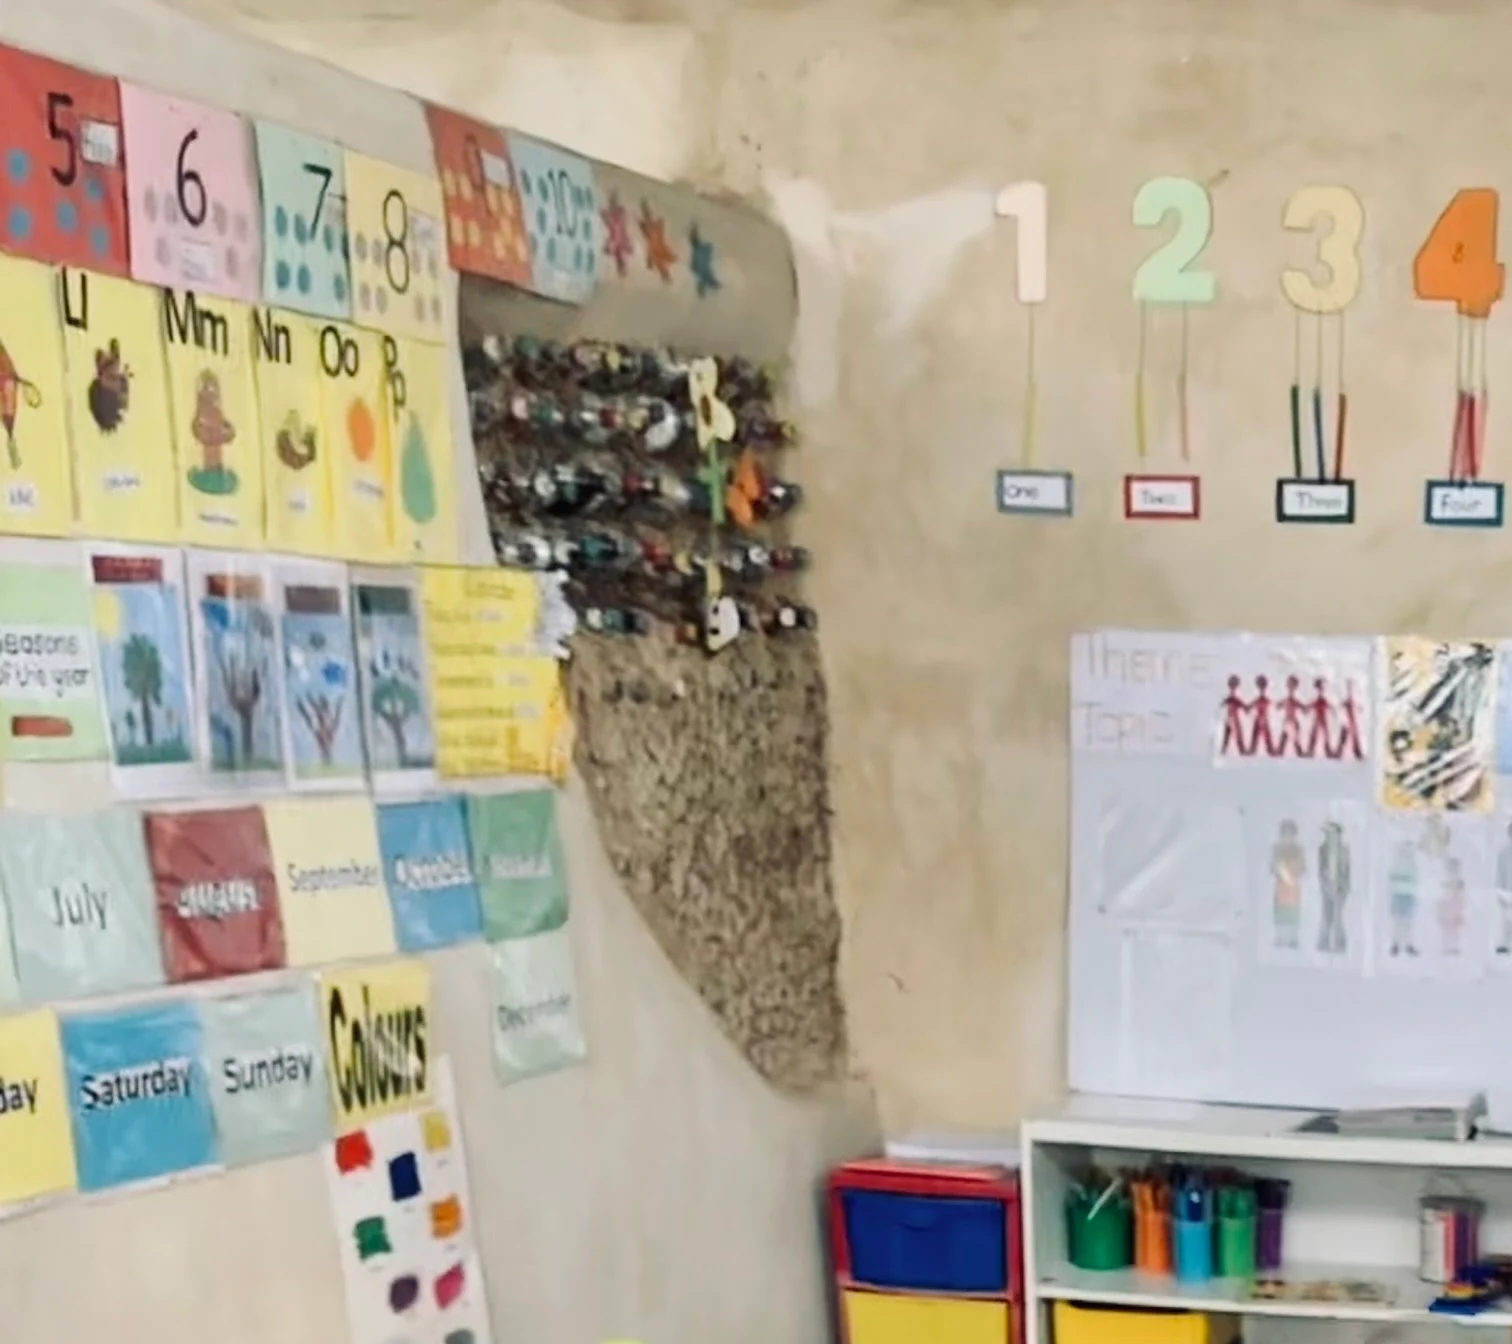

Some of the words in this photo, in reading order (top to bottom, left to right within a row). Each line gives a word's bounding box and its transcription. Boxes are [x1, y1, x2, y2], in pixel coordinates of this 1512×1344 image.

[46, 91, 77, 187] 5
[176, 128, 207, 227] 6
[303, 163, 333, 241] 7
[1132, 176, 1215, 302] 2
[382, 189, 410, 295] 8
[997, 181, 1048, 302] 1
[1281, 185, 1365, 314] 3
[1413, 188, 1506, 319] 4
[163, 286, 230, 357] Mm
[251, 305, 292, 365] Nn
[319, 325, 360, 379] Oo
[1440, 494, 1483, 514] Four
[0, 632, 80, 656] easons
[51, 881, 108, 931] July
[81, 1059, 194, 1112] Saturday
[223, 1049, 315, 1095] Sunday
[328, 984, 428, 1115] Colours
